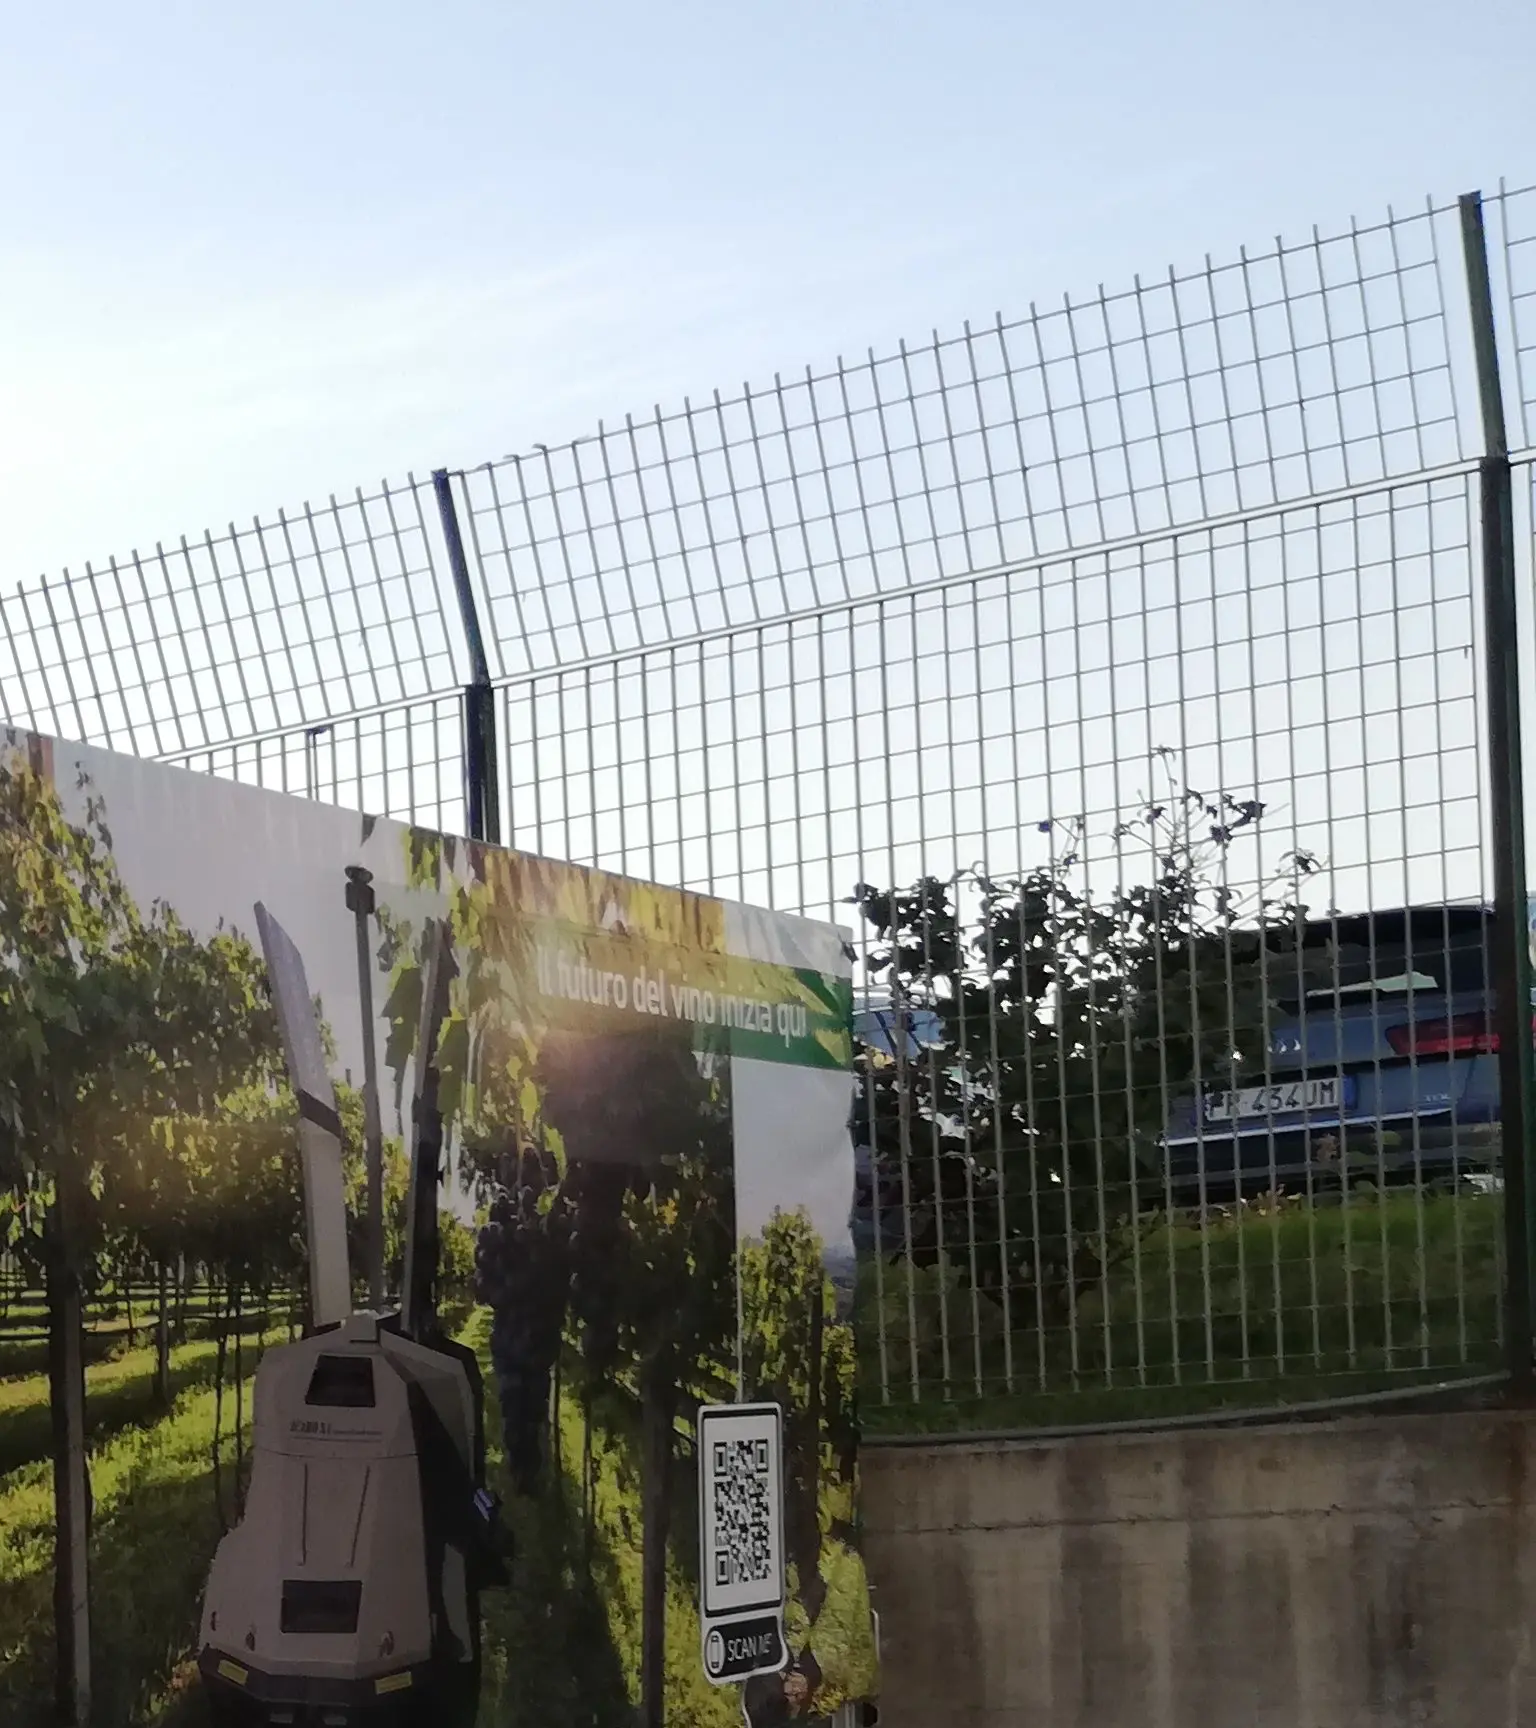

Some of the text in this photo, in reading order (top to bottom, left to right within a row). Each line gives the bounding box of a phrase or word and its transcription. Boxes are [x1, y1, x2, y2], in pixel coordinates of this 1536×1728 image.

[556, 949, 628, 1010] futuro
[633, 965, 668, 1016] del
[670, 973, 715, 1023] vino
[719, 980, 772, 1035] inizia
[777, 996, 807, 1048] qui
[727, 1636, 757, 1661] SCAN
